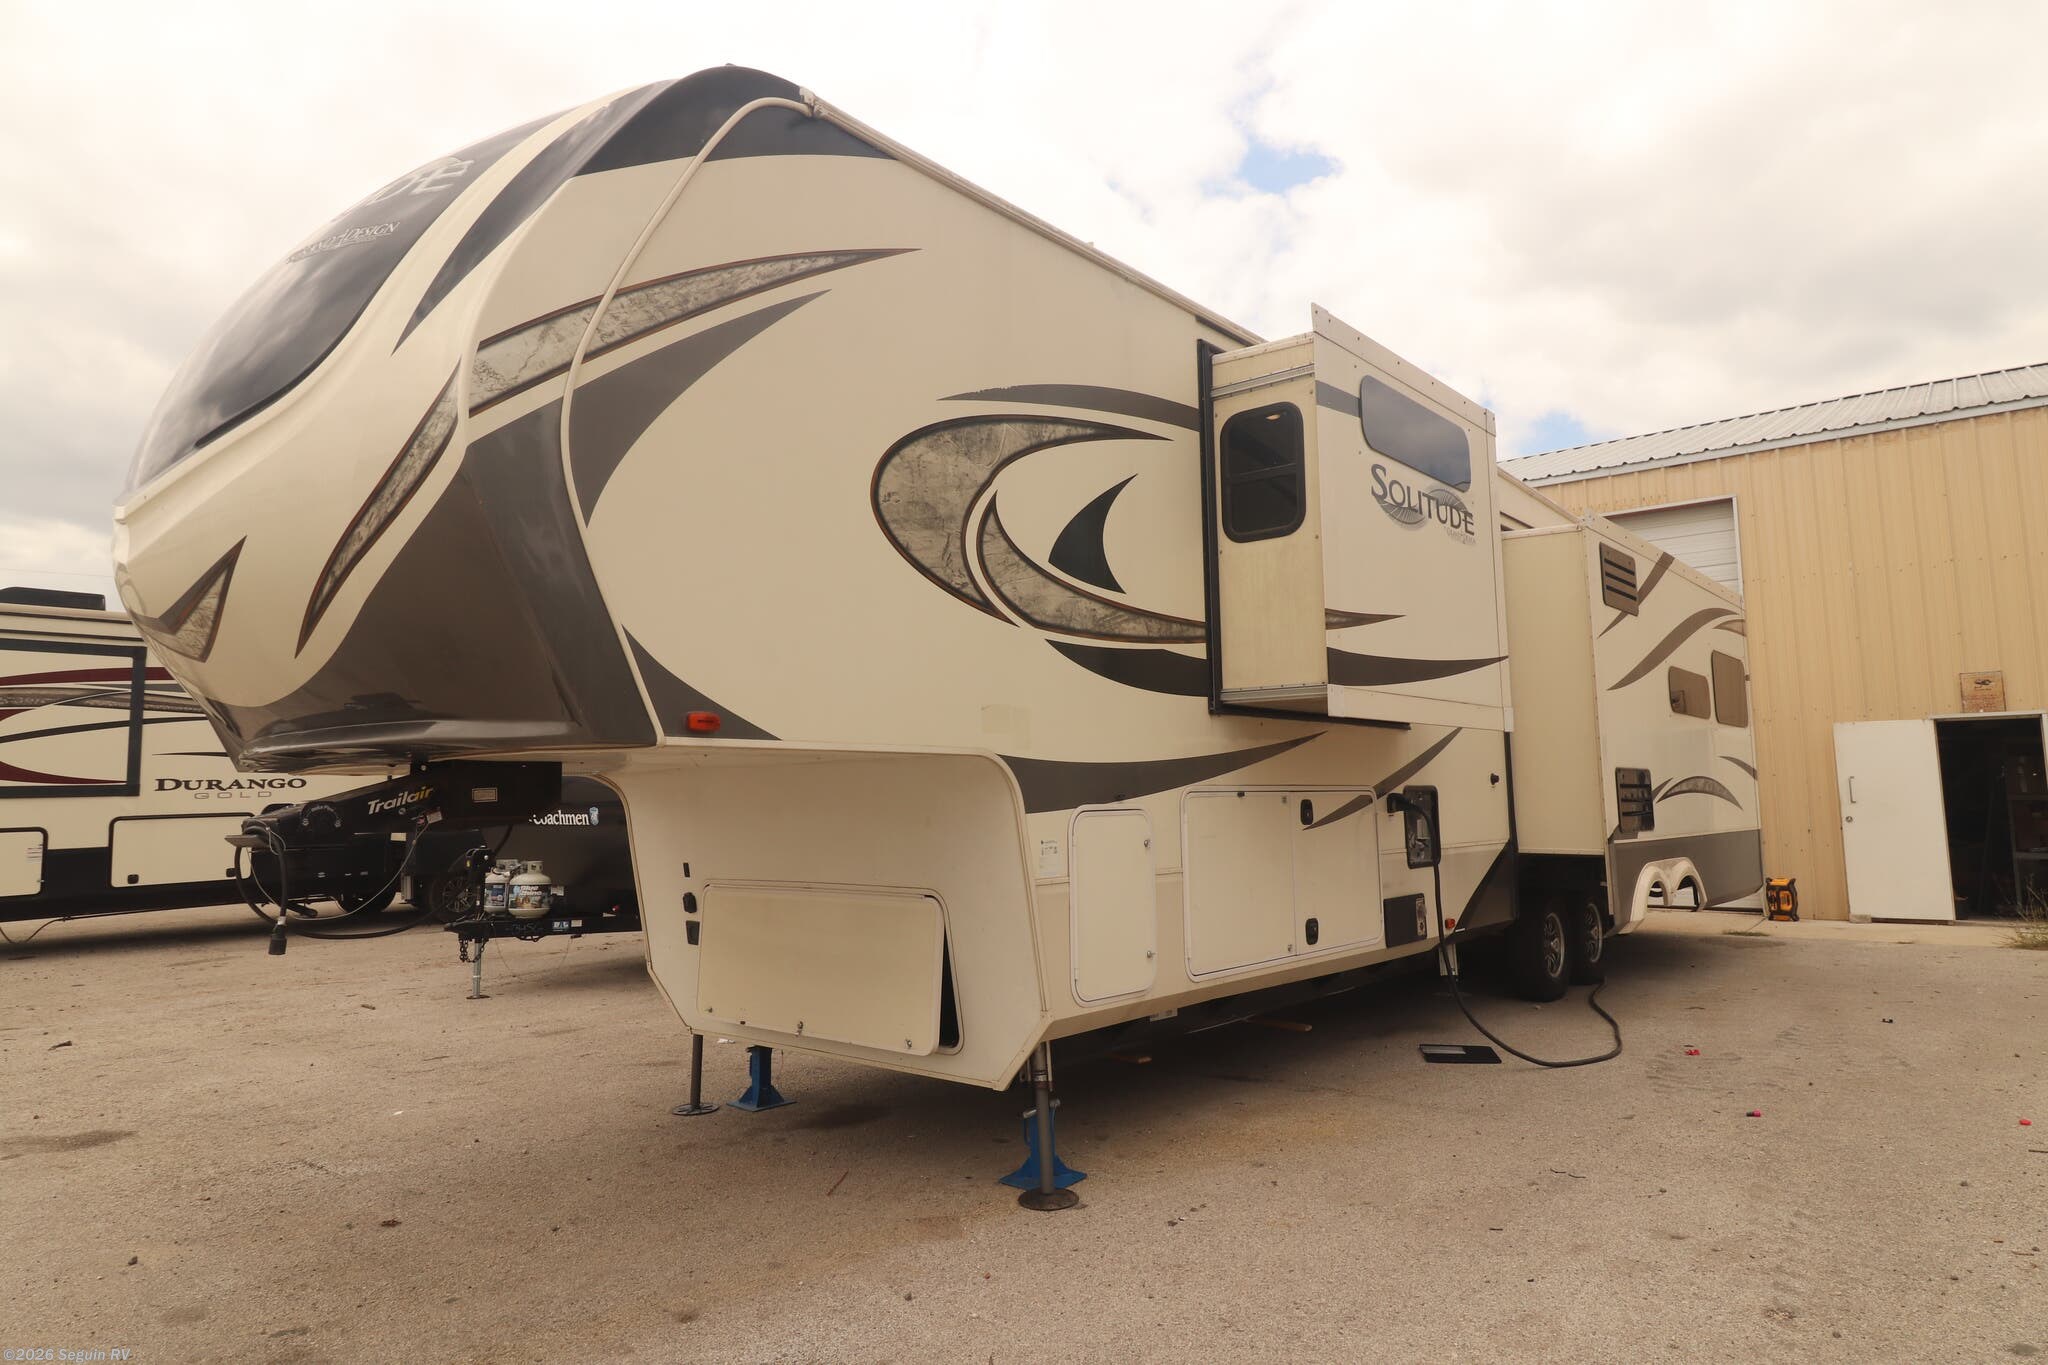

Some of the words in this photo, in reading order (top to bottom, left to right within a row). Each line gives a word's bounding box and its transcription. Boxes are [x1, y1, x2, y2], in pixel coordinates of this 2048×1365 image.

[1371, 464, 1475, 536] SOLITUDE
[154, 778, 307, 792] DURANGO
[193, 791, 272, 799] GOLD
[367, 786, 433, 815] Trailair
